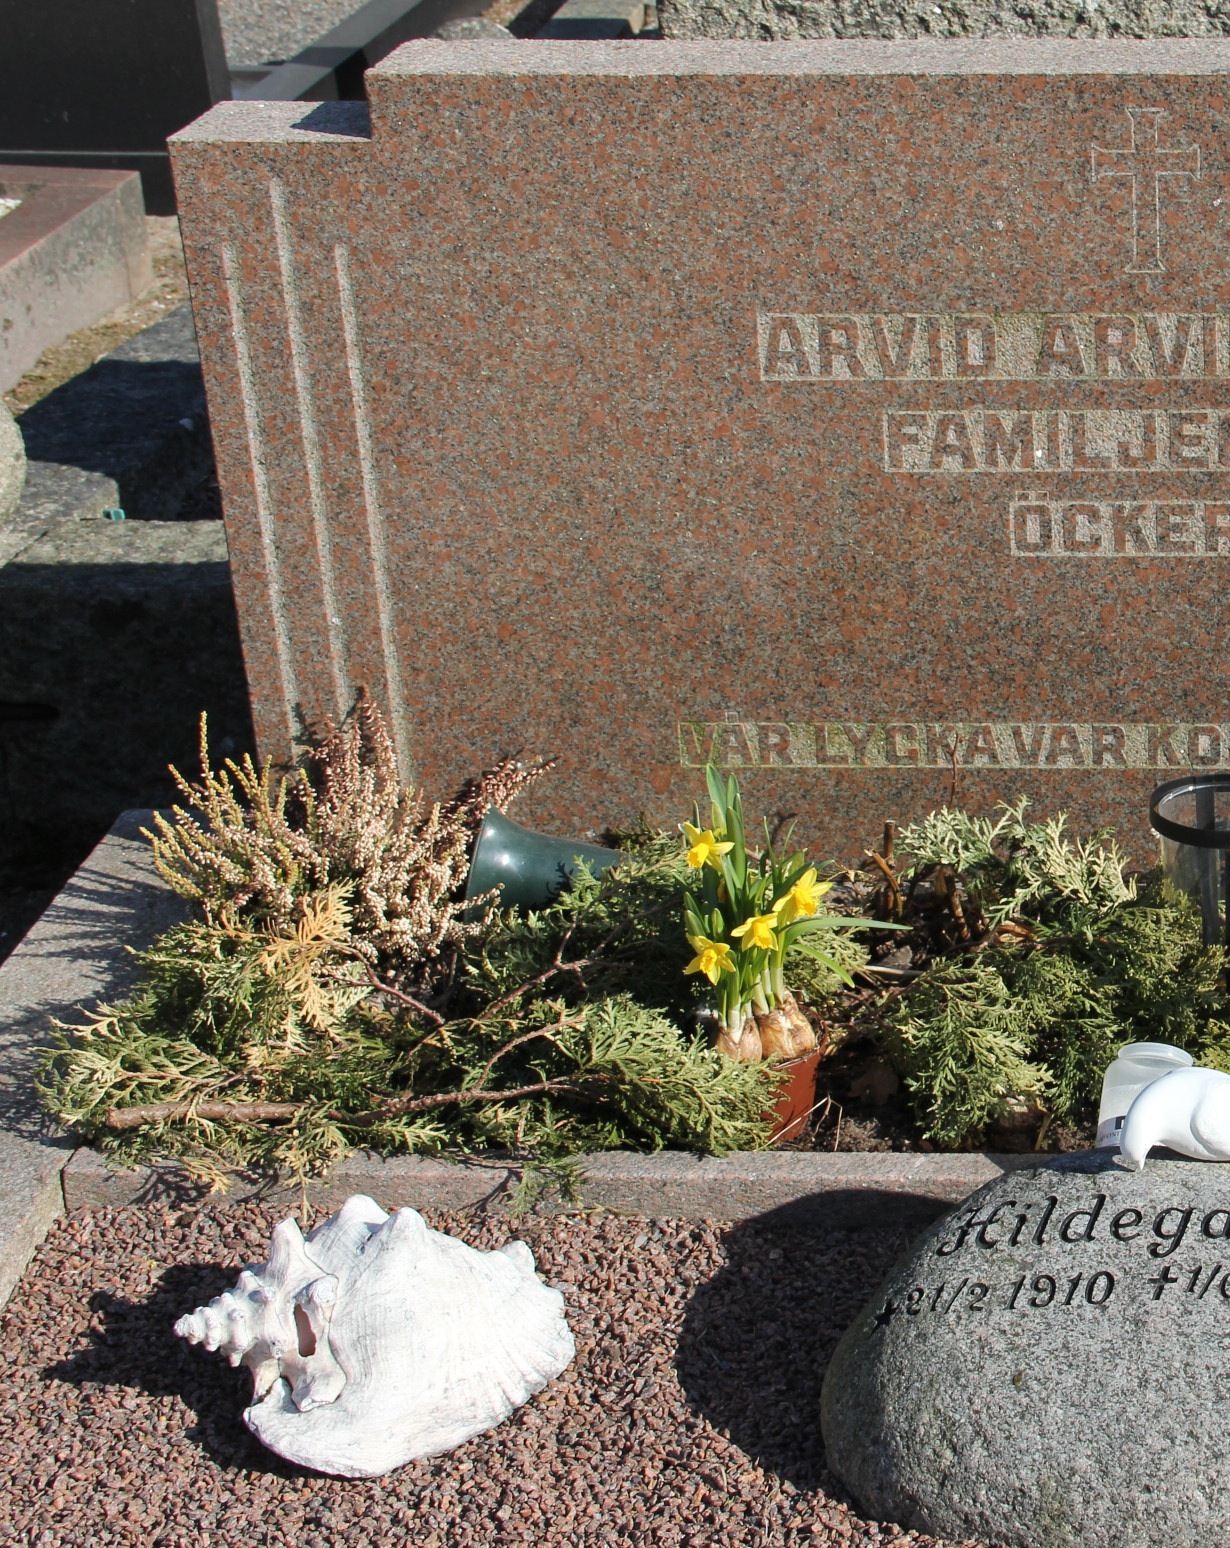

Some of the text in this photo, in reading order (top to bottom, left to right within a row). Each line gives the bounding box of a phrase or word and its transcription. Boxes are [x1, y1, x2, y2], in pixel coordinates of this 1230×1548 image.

[763, 312, 998, 379] ARVID
[814, 722, 1000, 768] LYCKA
[1010, 722, 1130, 768] VAR
[1003, 1270, 1116, 1310] 1910
